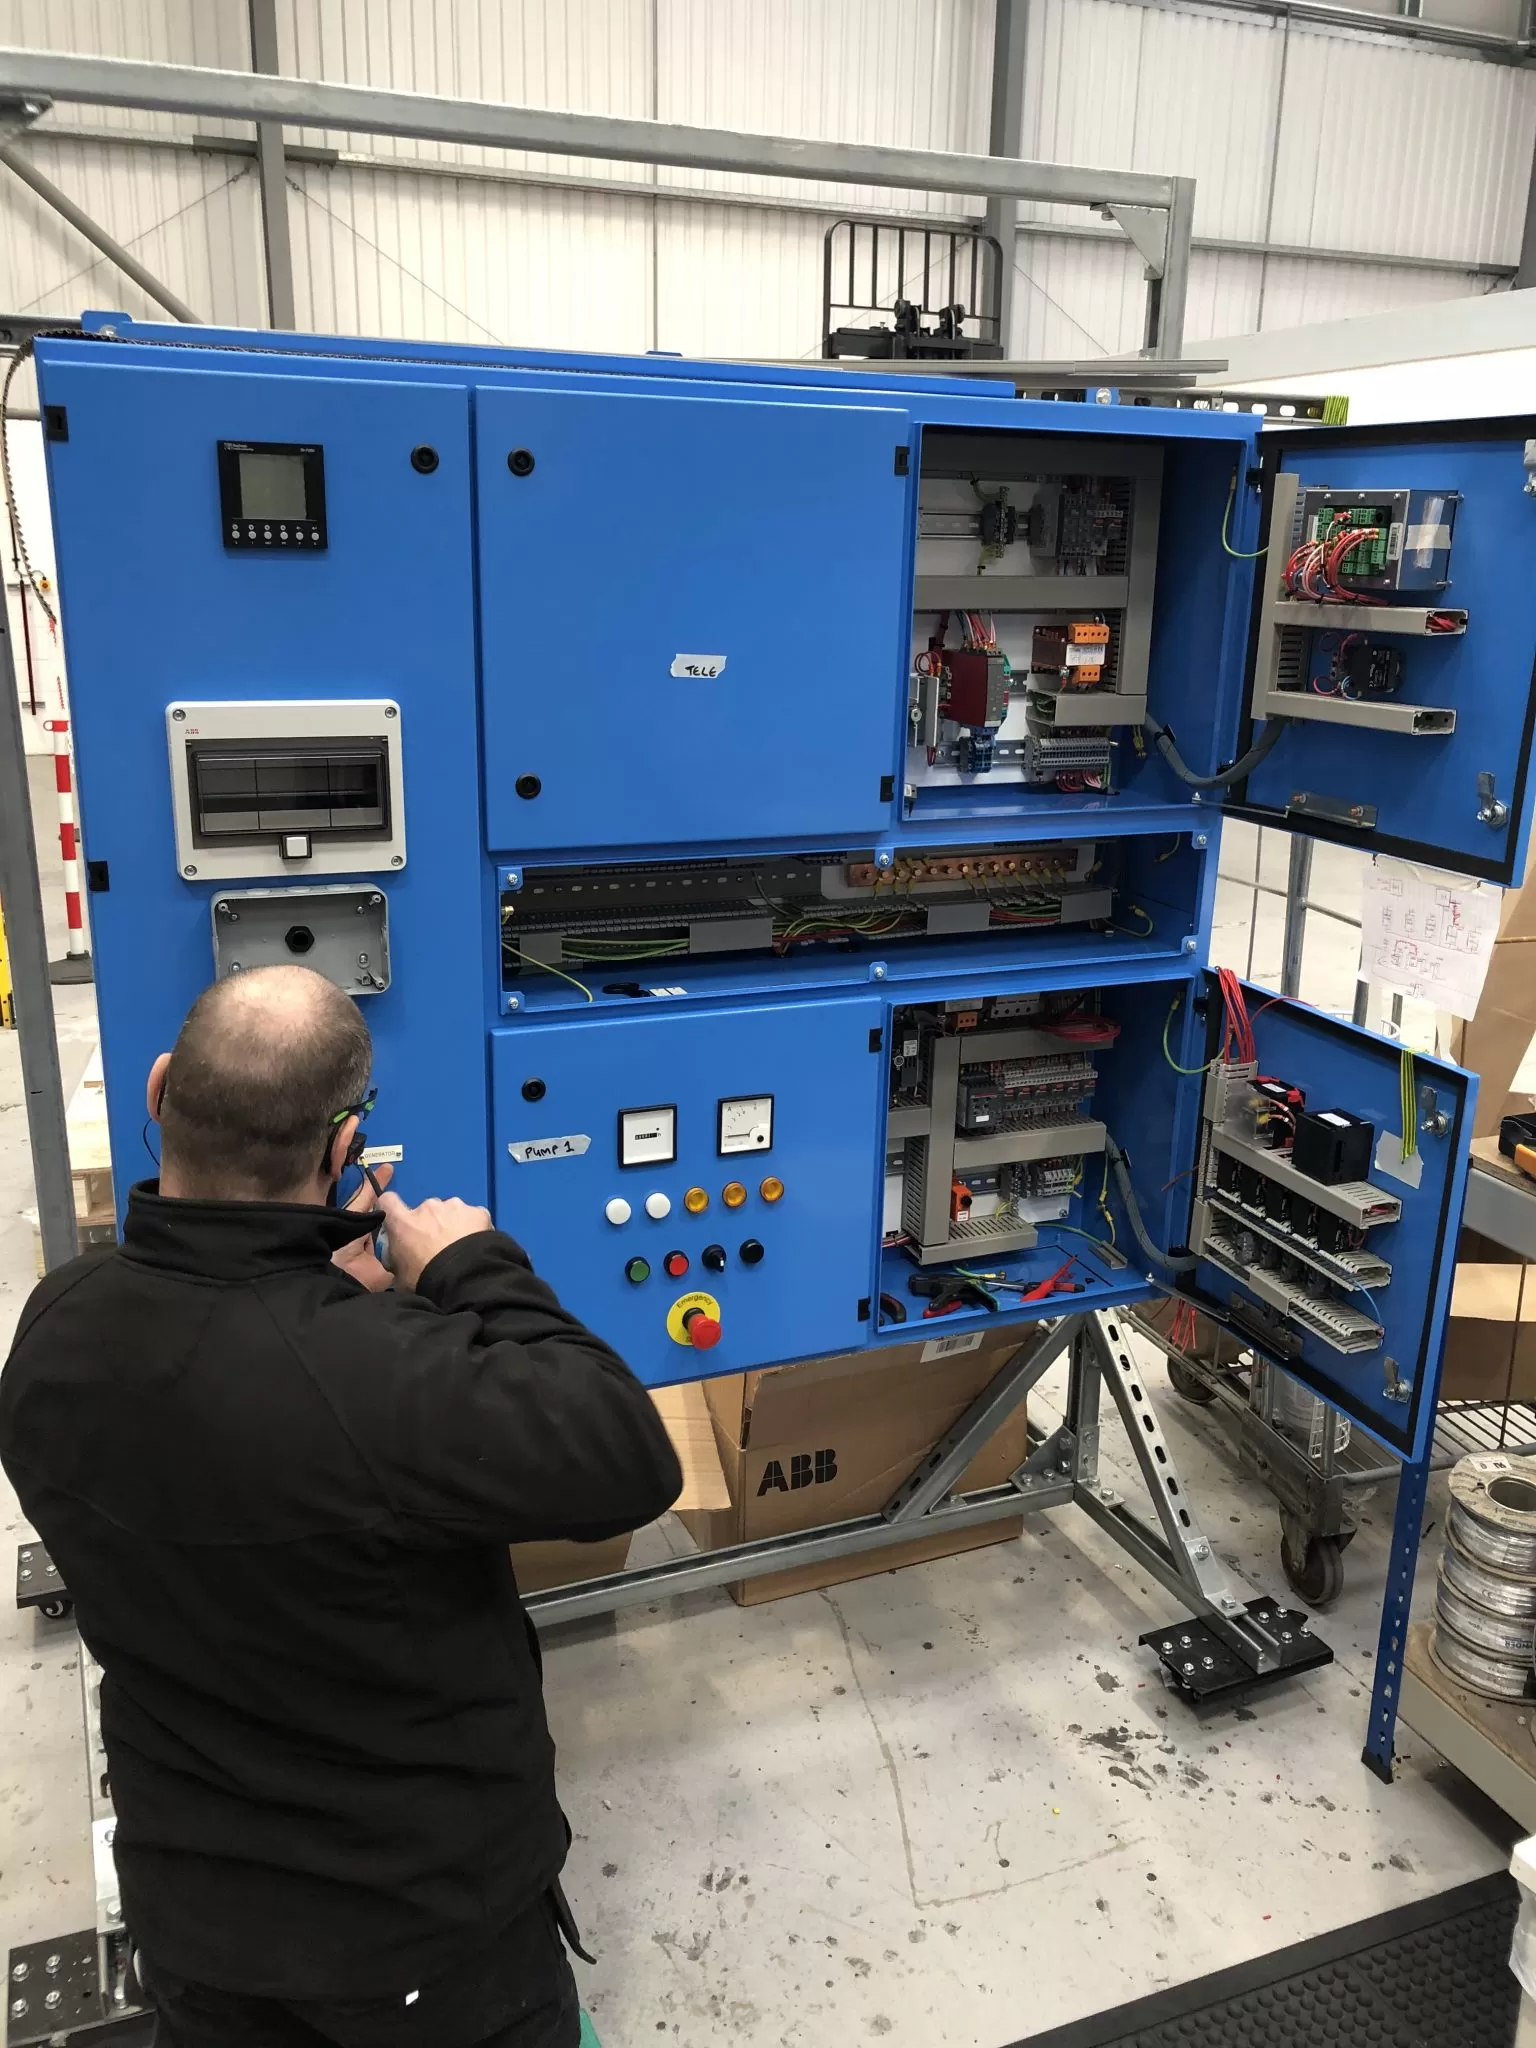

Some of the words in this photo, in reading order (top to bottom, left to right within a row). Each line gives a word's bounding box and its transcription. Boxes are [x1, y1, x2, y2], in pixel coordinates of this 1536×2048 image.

[684, 665, 717, 677] TELE
[564, 1140, 575, 1153] 1
[676, 1294, 714, 1309] Emergency
[756, 1448, 838, 1497] ABB
